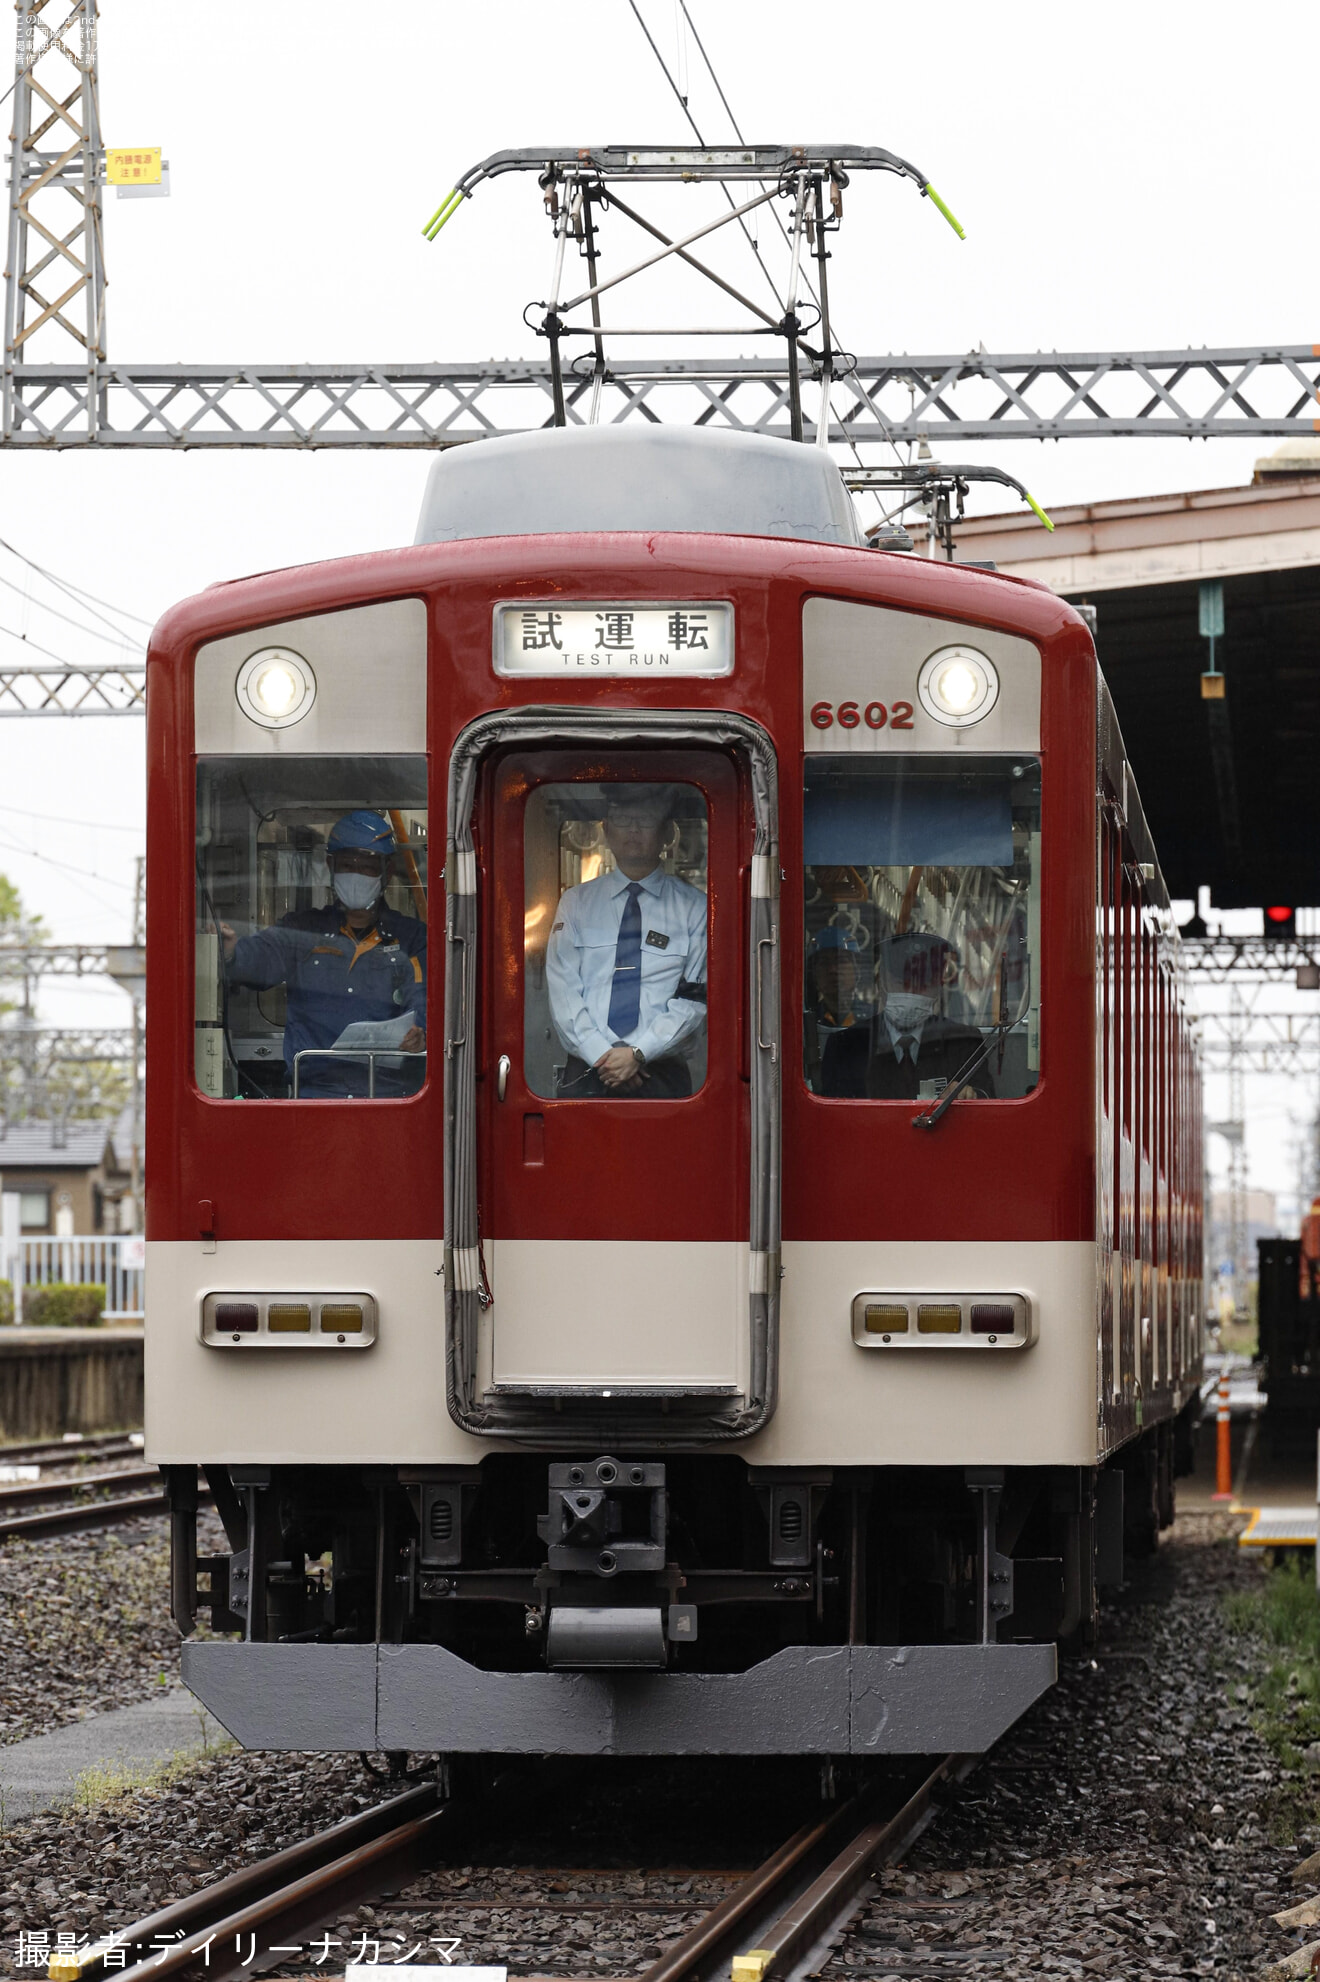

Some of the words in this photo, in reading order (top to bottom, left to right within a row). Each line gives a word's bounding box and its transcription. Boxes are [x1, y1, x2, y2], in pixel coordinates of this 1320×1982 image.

[521, 612, 709, 650] 試運転
[562, 654, 613, 665] TEST
[629, 654, 669, 665] RUN
[810, 701, 914, 729] 6602
